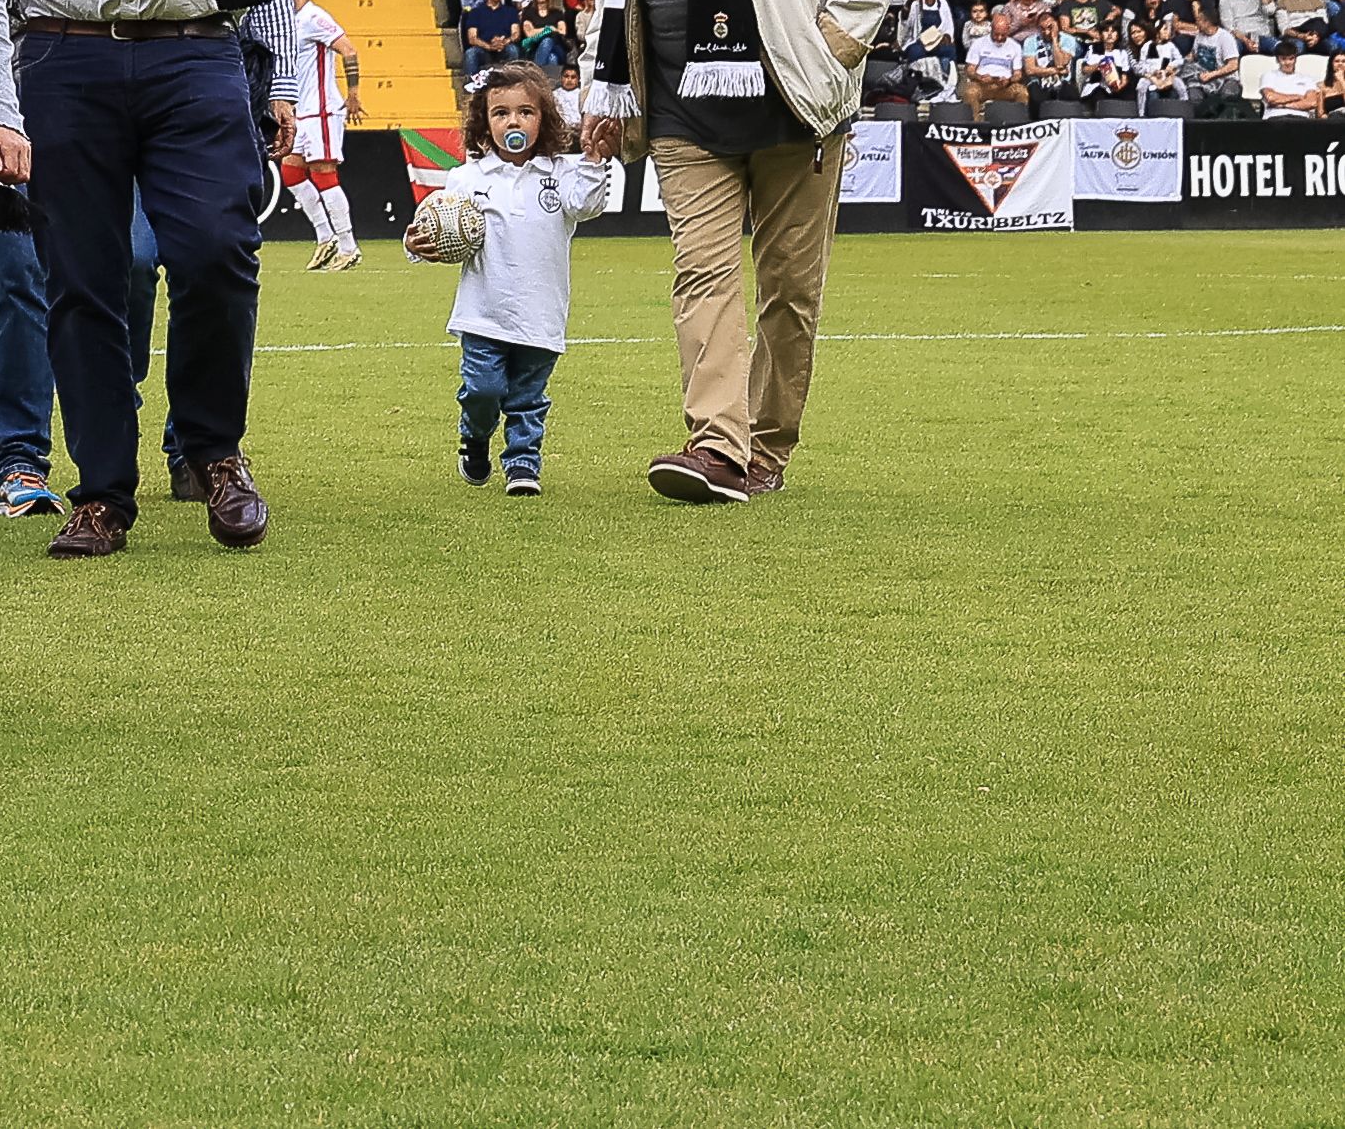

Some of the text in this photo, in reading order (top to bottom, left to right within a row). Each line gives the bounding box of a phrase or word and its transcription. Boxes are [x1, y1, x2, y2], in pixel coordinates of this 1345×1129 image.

[925, 121, 1060, 142] AUPA UNION
[1189, 154, 1292, 198] HOTEL
